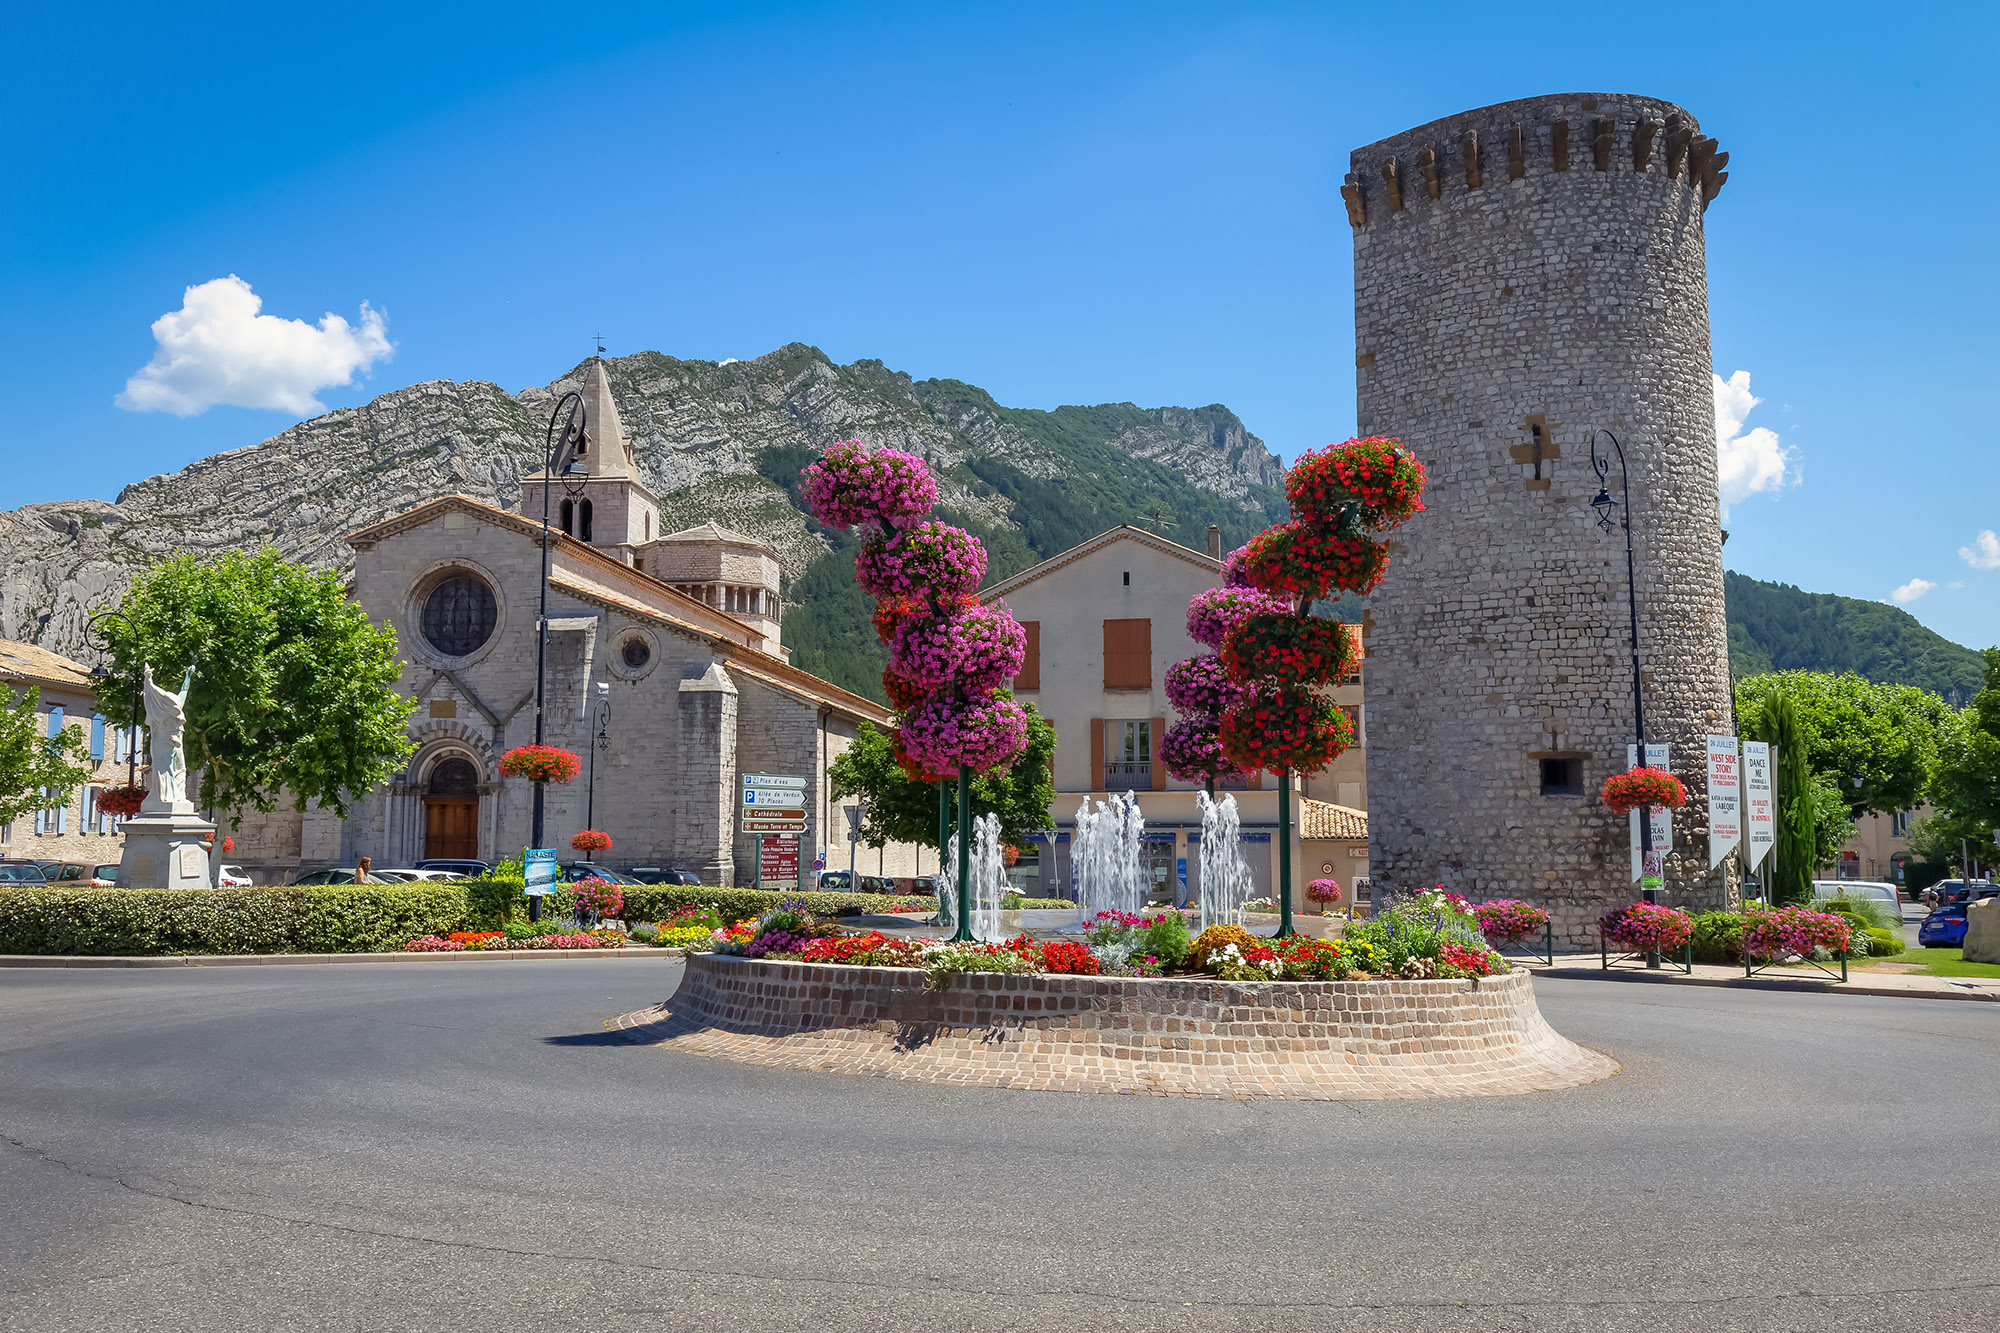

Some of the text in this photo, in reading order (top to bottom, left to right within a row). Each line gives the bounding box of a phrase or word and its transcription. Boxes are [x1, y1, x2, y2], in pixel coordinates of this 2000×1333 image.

[1710, 753, 1737, 764] WEST SIDE
[1749, 759, 1766, 768] DANCE
[1715, 764, 1732, 774] STORY
[1755, 769, 1763, 777] ME
